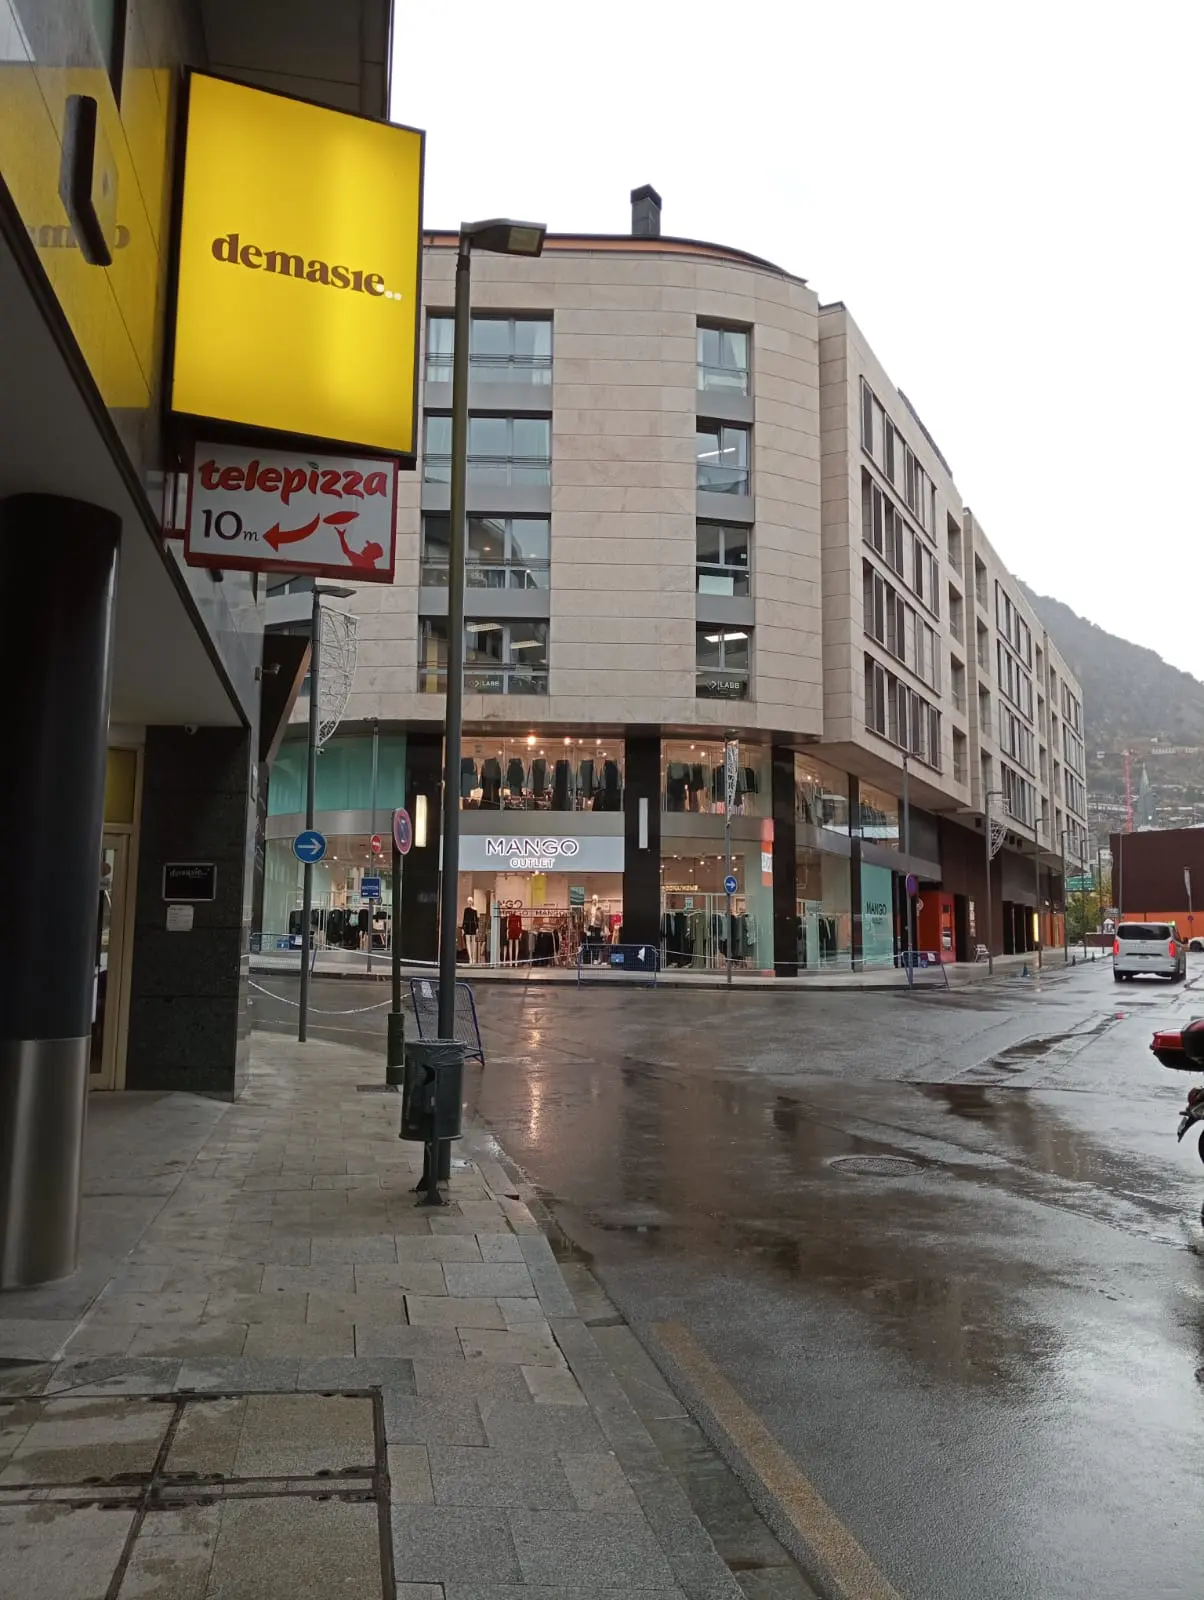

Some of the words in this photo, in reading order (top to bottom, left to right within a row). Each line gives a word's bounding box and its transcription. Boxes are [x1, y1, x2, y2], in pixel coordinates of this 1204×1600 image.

[199, 459, 388, 506] telepizza
[485, 838, 579, 857] MANGO
[510, 857, 555, 868] OUTLET
[867, 901, 886, 915] MANGO
